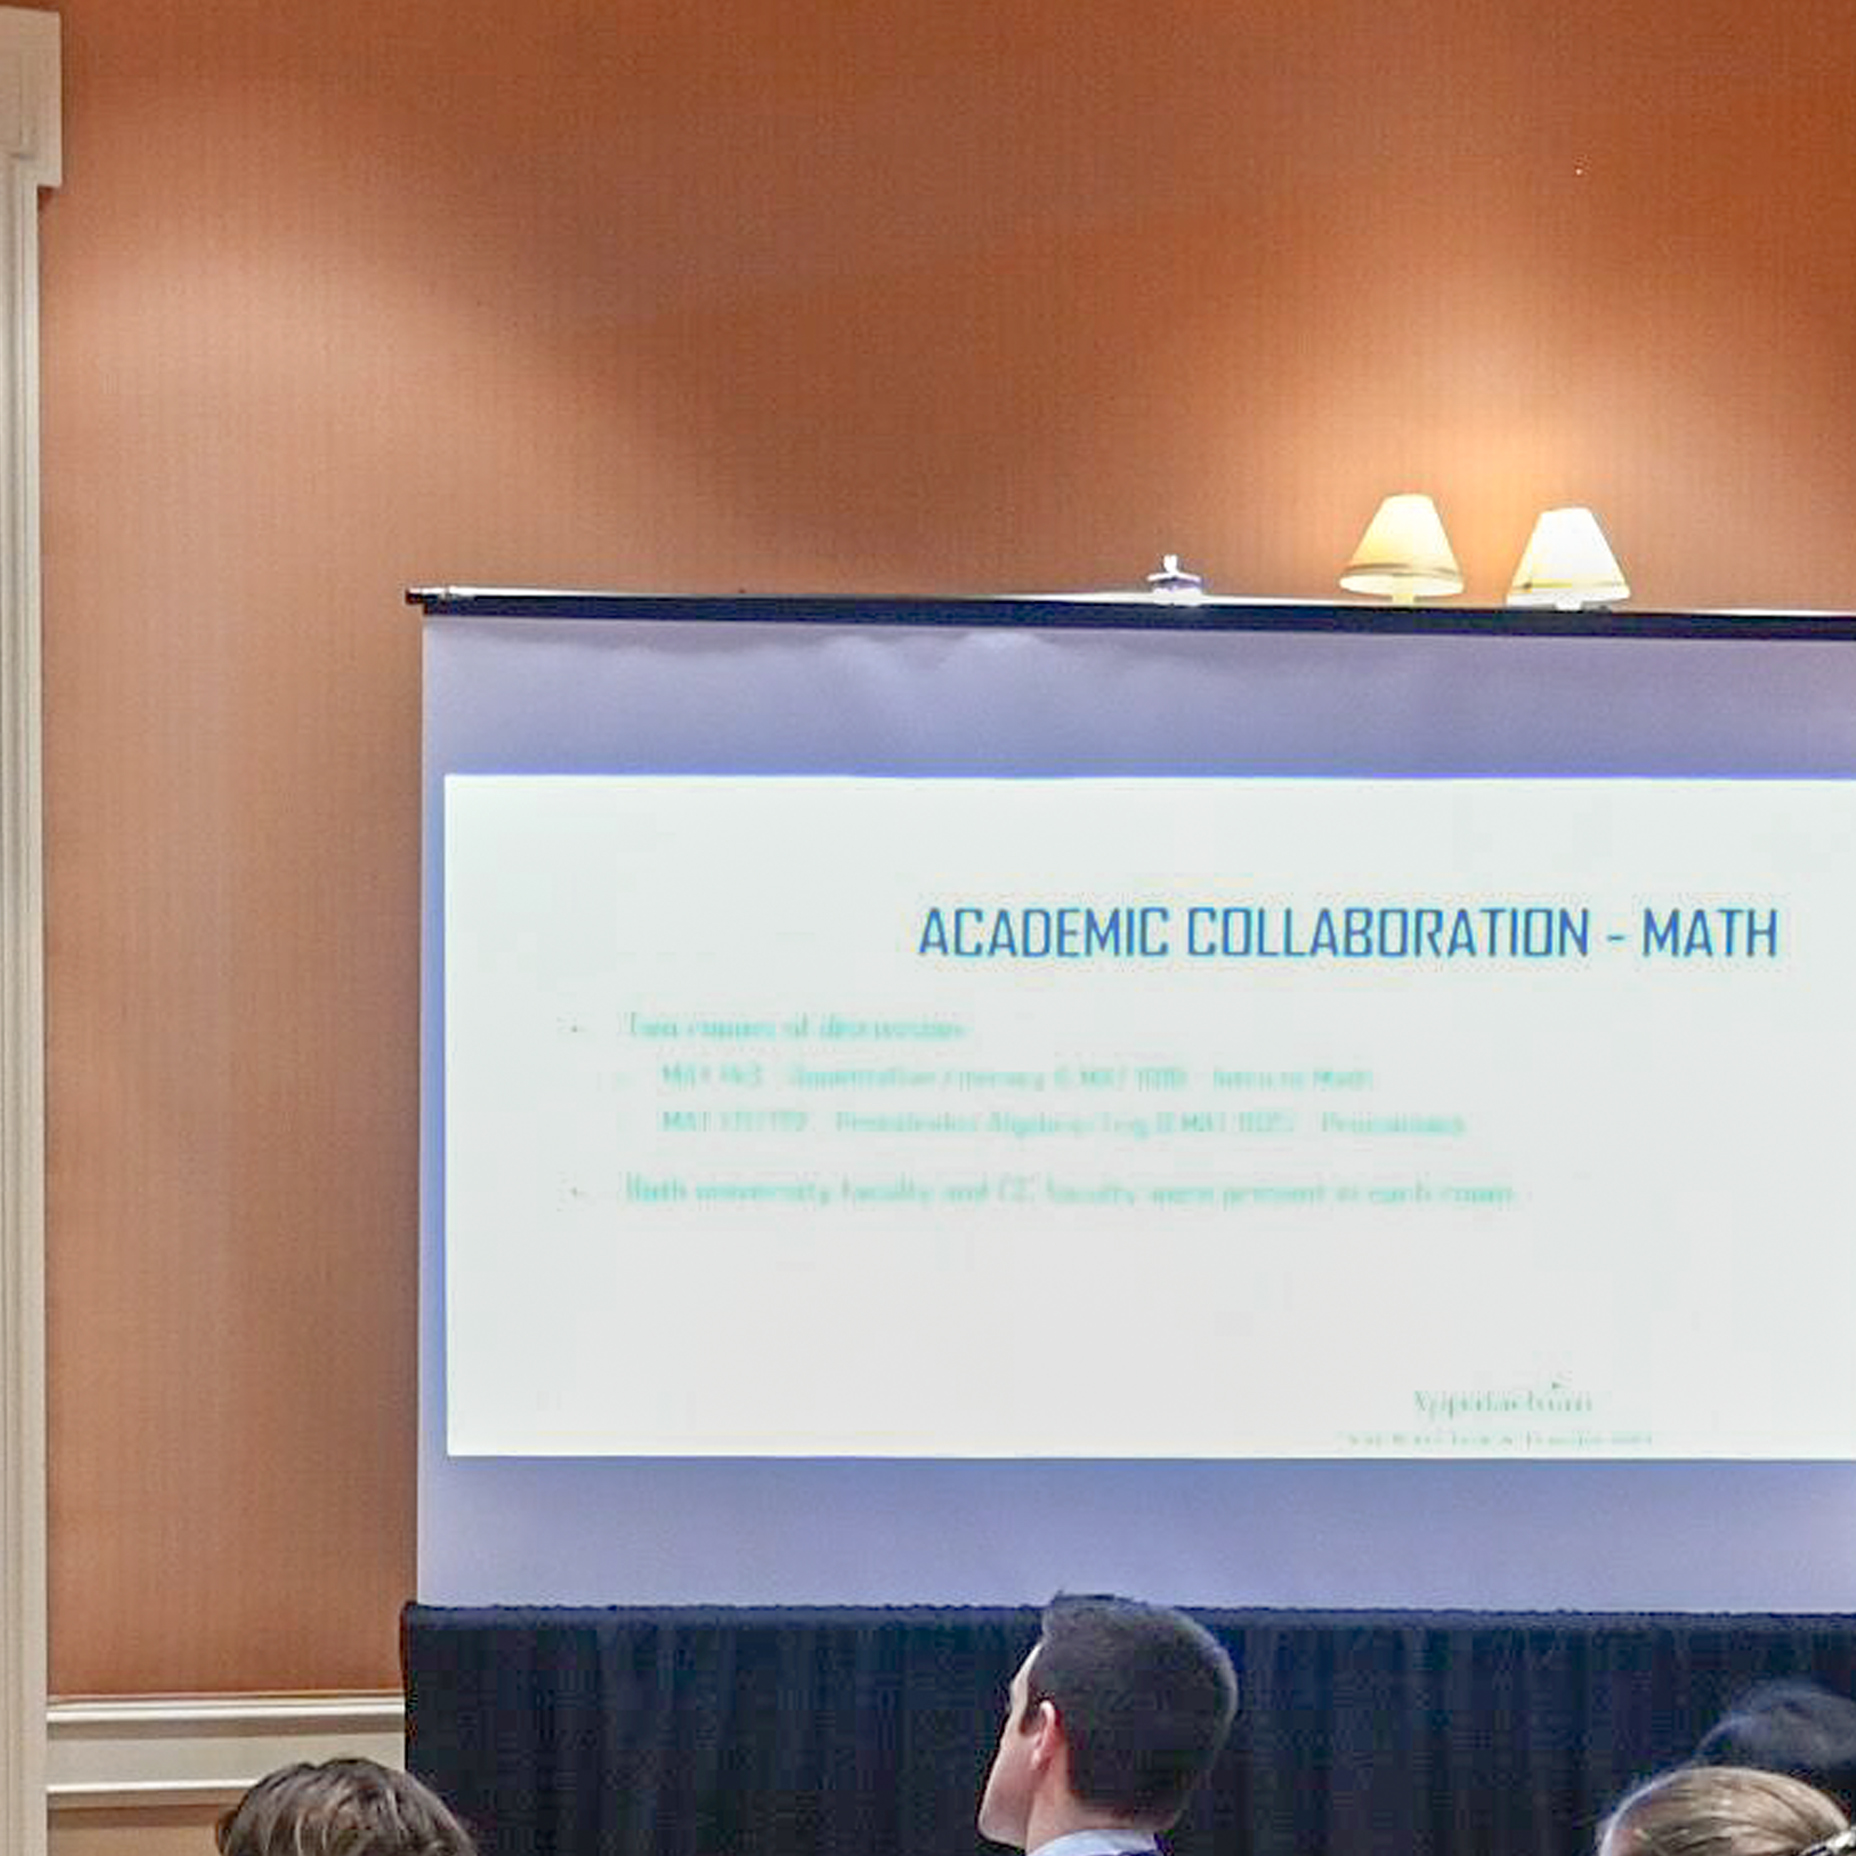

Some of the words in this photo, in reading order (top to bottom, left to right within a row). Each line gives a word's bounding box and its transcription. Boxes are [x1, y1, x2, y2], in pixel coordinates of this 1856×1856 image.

[918, 906, 1170, 958] ACADEMIC
[1187, 906, 1590, 958] COLLABORATION
[1642, 906, 1779, 959] MATH
